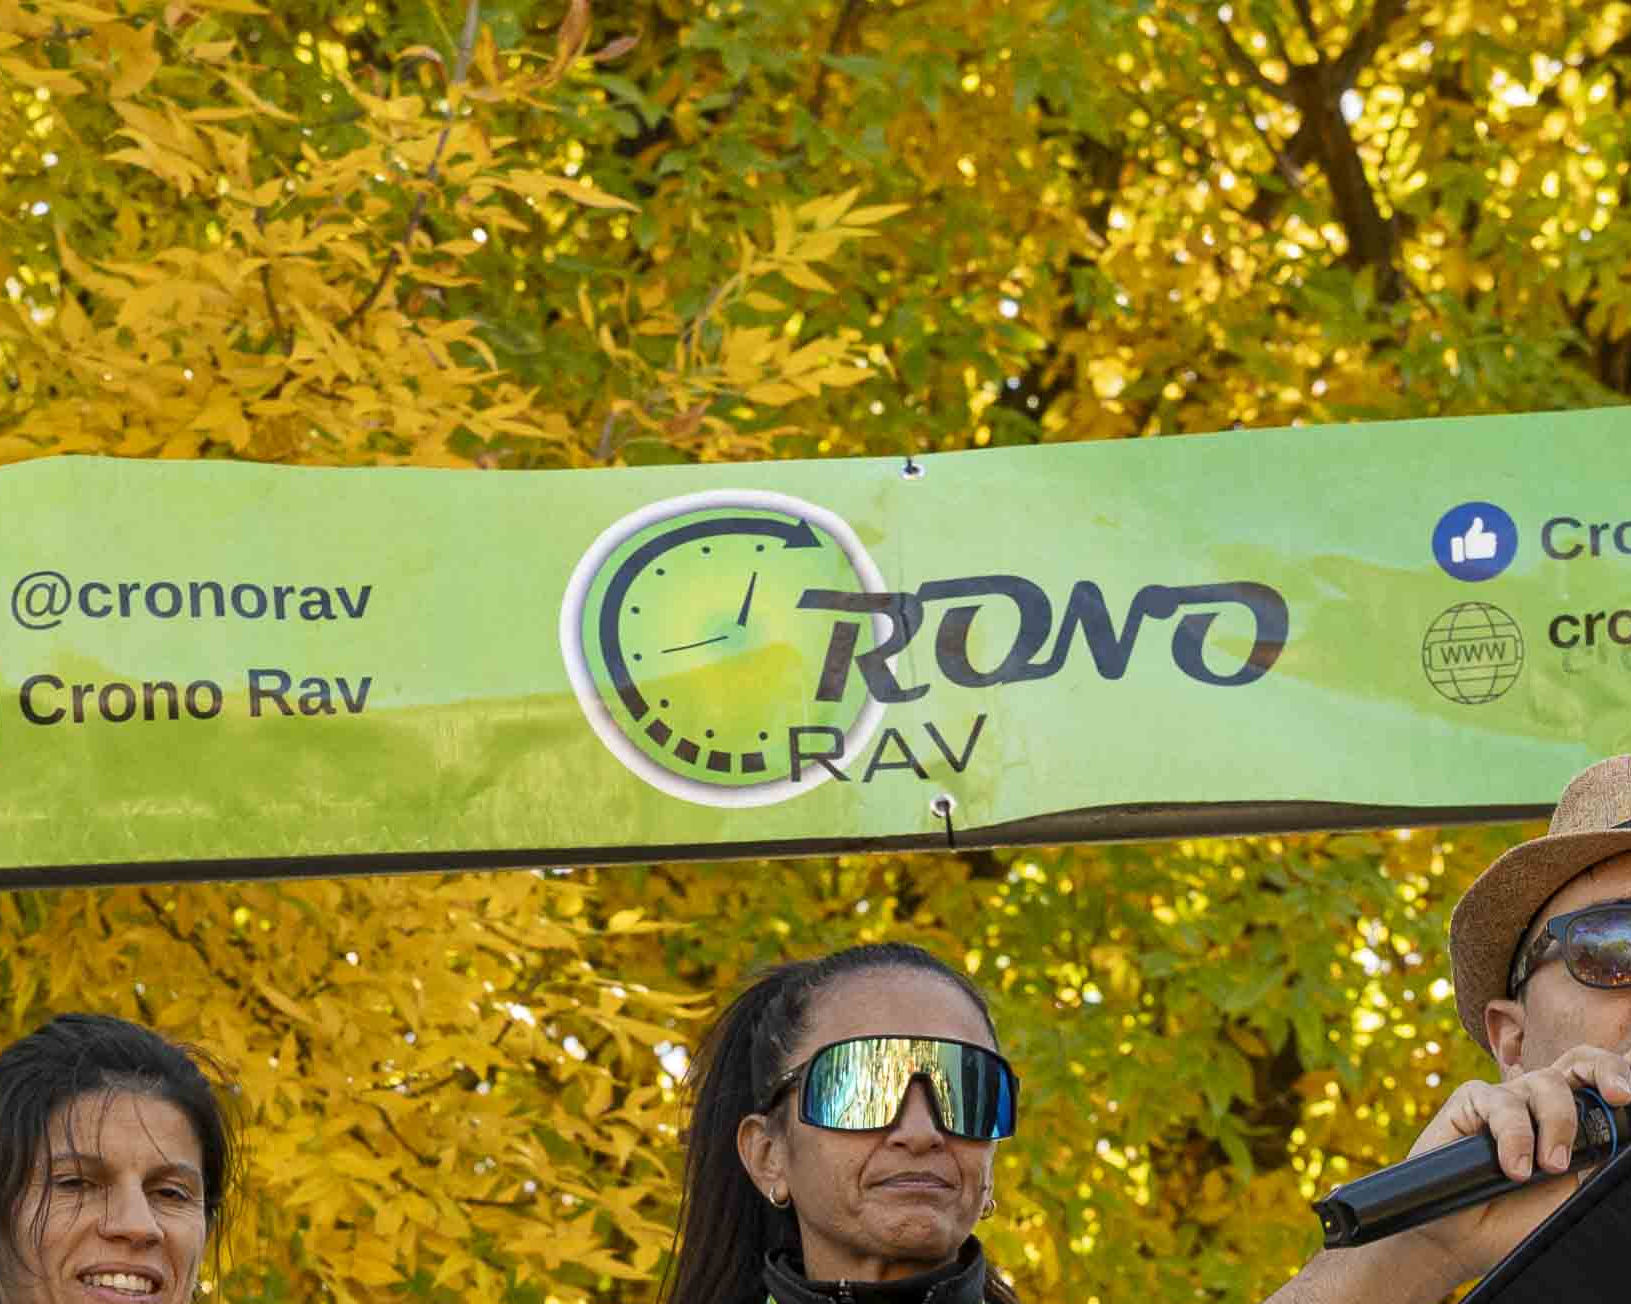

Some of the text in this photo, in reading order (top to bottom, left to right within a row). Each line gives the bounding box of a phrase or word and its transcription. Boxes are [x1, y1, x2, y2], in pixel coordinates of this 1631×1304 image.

[11, 570, 372, 630] @cronorav
[19, 668, 372, 726] Crono Rav
[789, 714, 987, 783] RAV
